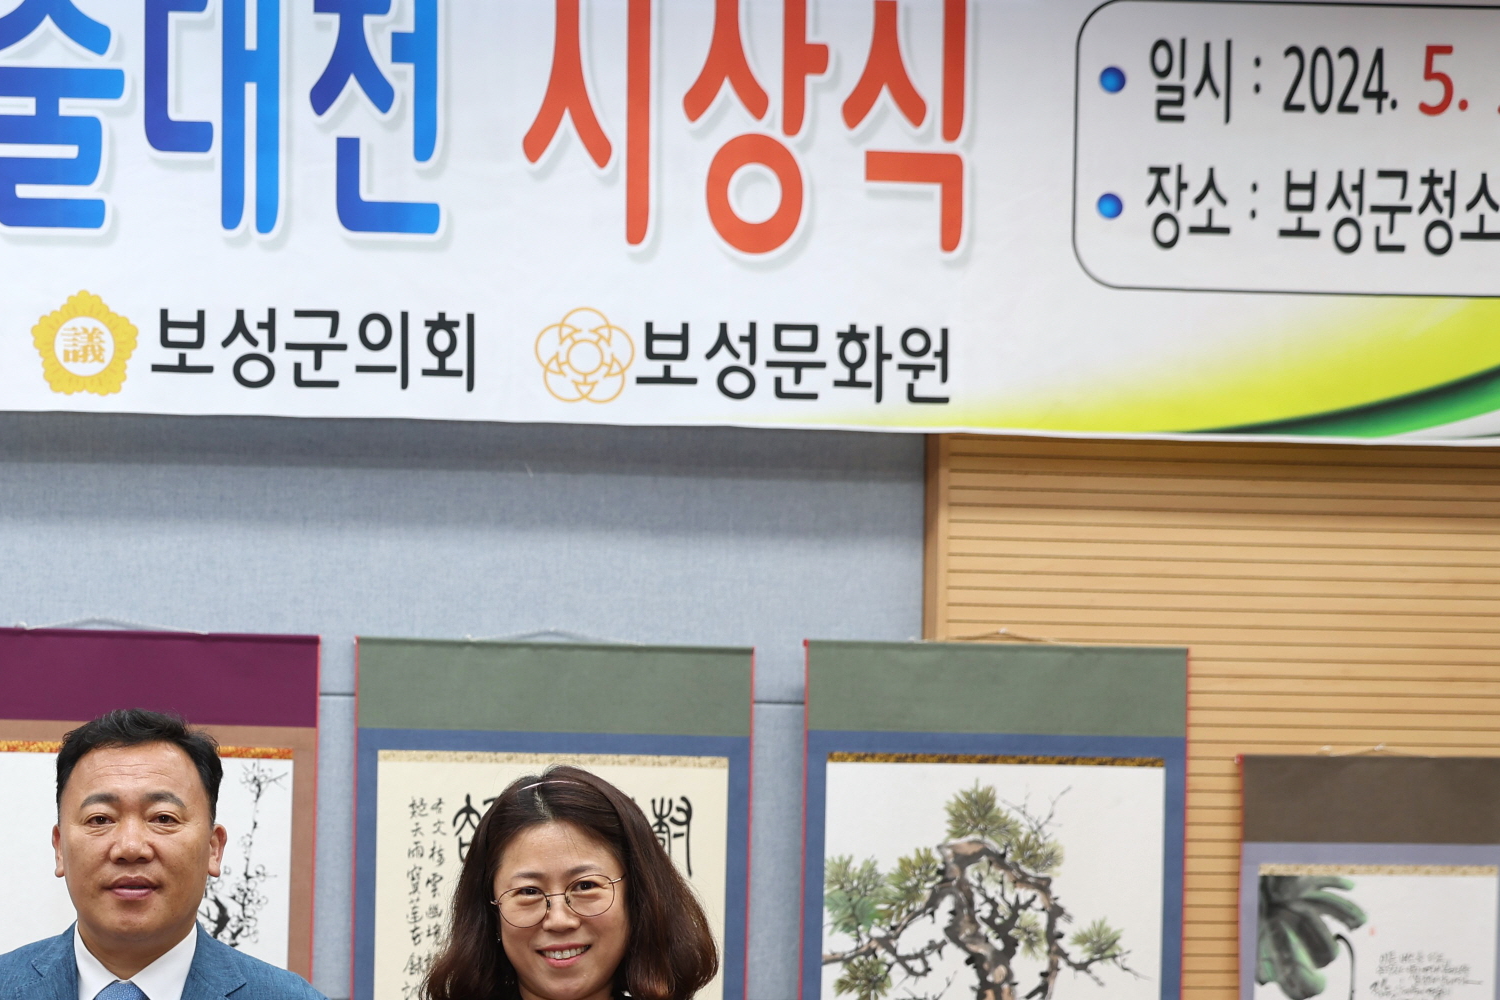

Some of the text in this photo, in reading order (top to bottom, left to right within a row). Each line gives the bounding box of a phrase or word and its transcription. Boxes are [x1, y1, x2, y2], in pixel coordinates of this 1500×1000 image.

[1150, 38, 1233, 124] 일시
[1282, 46, 1398, 116] 2024.
[522, 0, 966, 254] 시상식
[1145, 164, 1232, 249] 장소
[1278, 168, 1500, 256] 보성군청소
[151, 307, 476, 392] 보성군의회
[636, 321, 951, 404] 보성문화원
